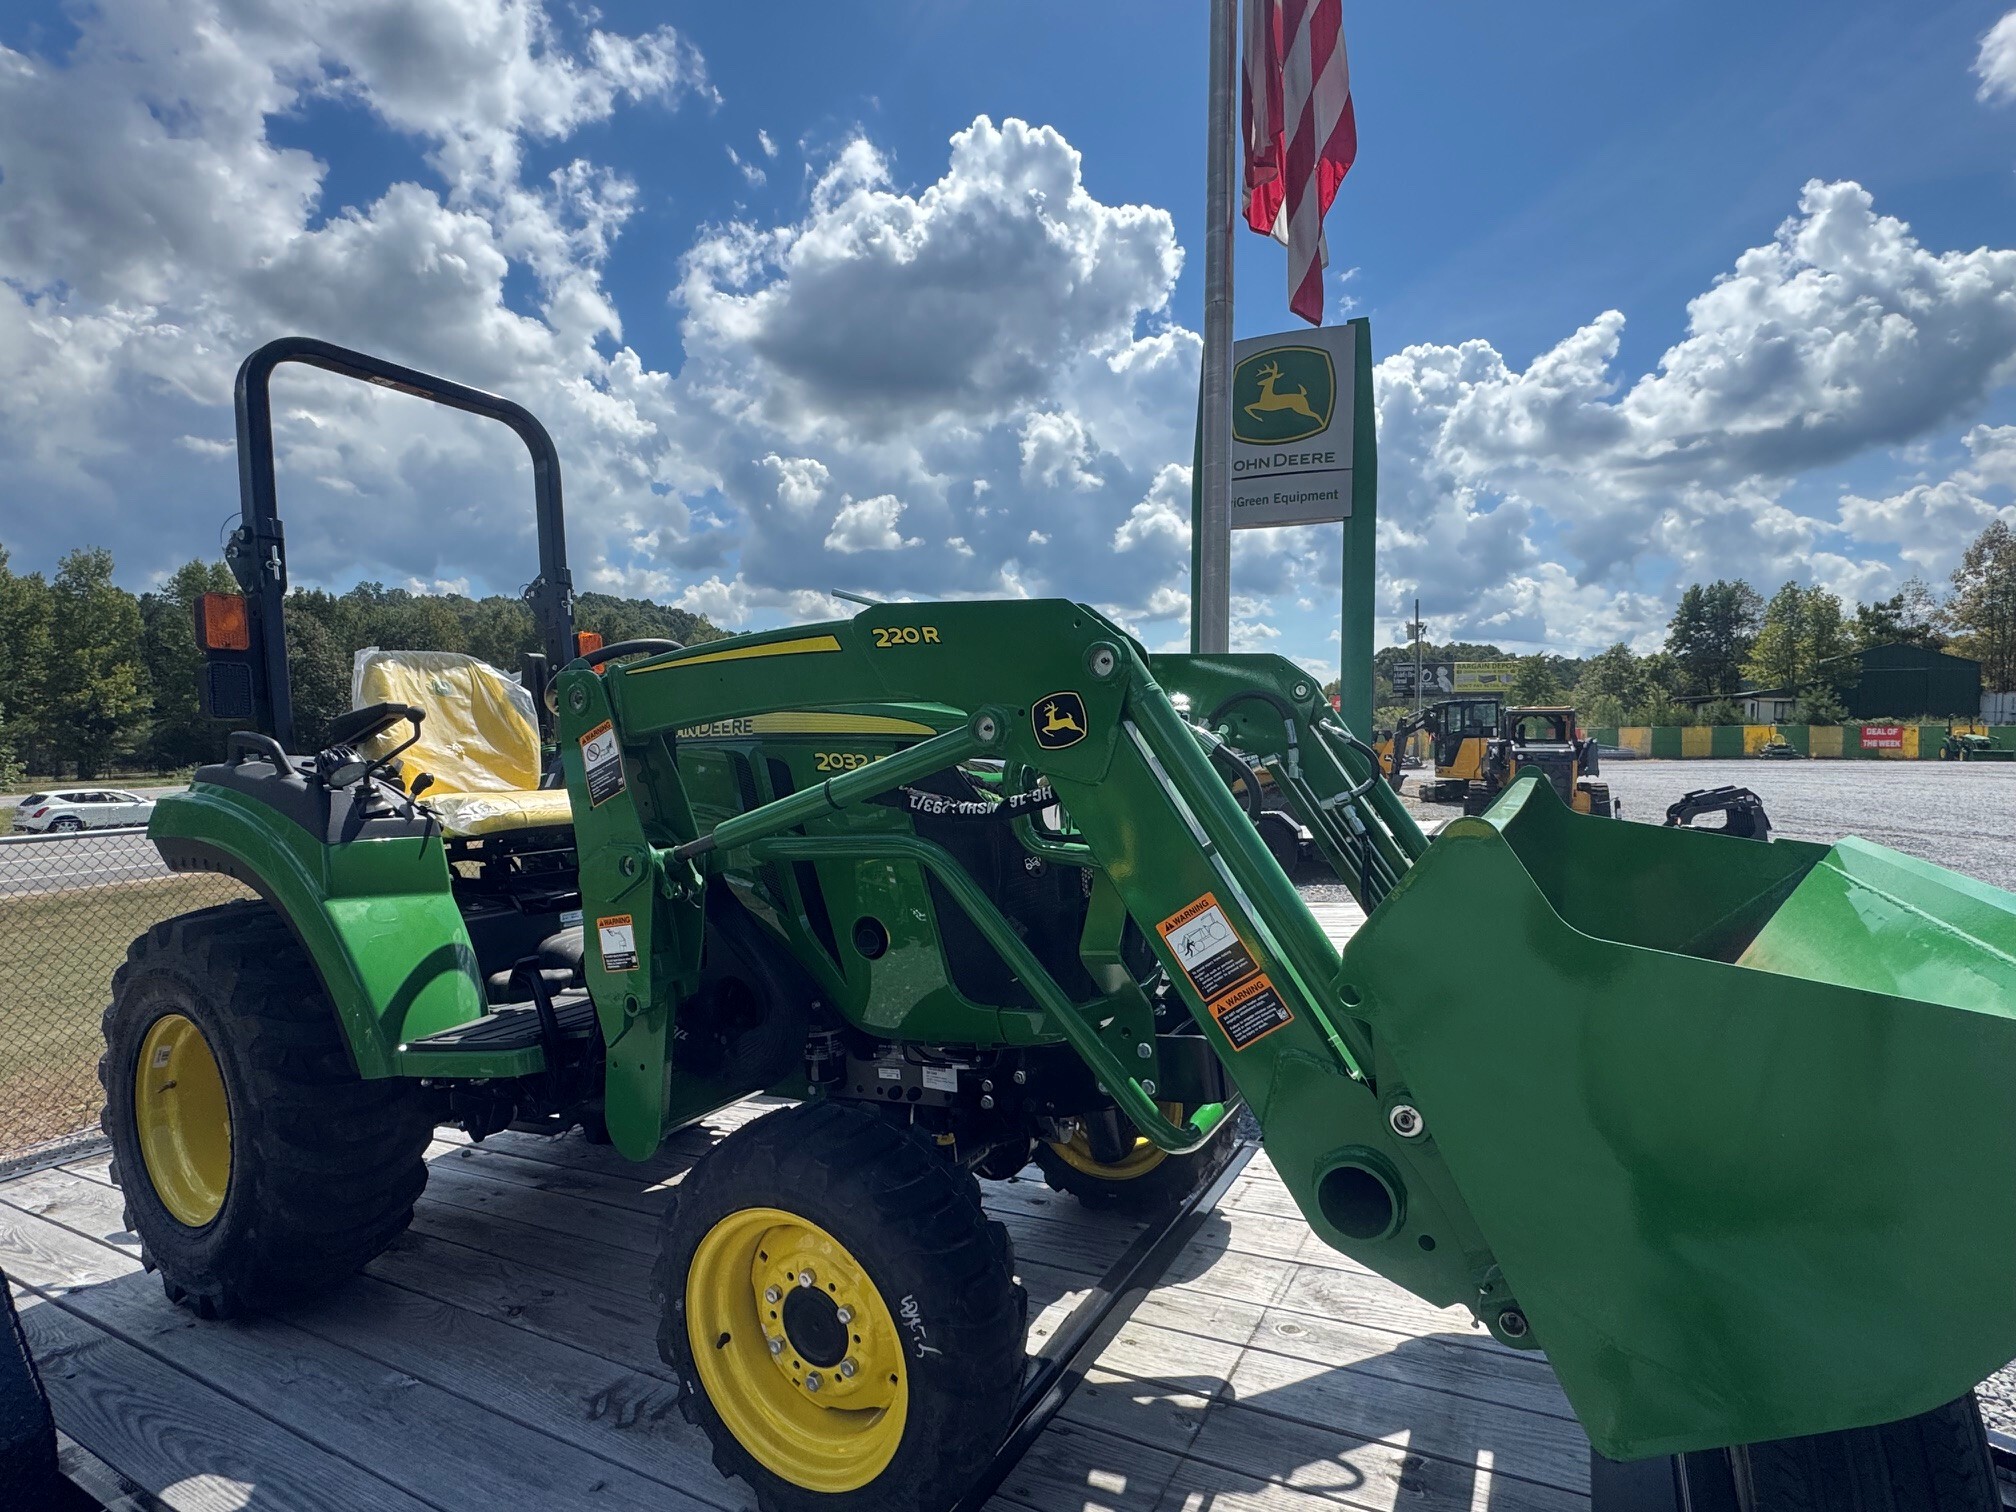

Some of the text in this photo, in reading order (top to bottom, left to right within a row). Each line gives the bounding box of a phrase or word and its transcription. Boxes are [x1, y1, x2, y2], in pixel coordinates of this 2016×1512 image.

[1233, 452, 1336, 472] OHN DEERE
[1232, 489, 1339, 508] iGreen Equipment
[585, 721, 611, 742] WARNING
[699, 719, 754, 737] DEERE
[1866, 728, 1899, 736] DEAL OF
[604, 916, 631, 926] WARNING
[1172, 899, 1209, 926] WARNING
[1225, 981, 1265, 1006] WARNING
